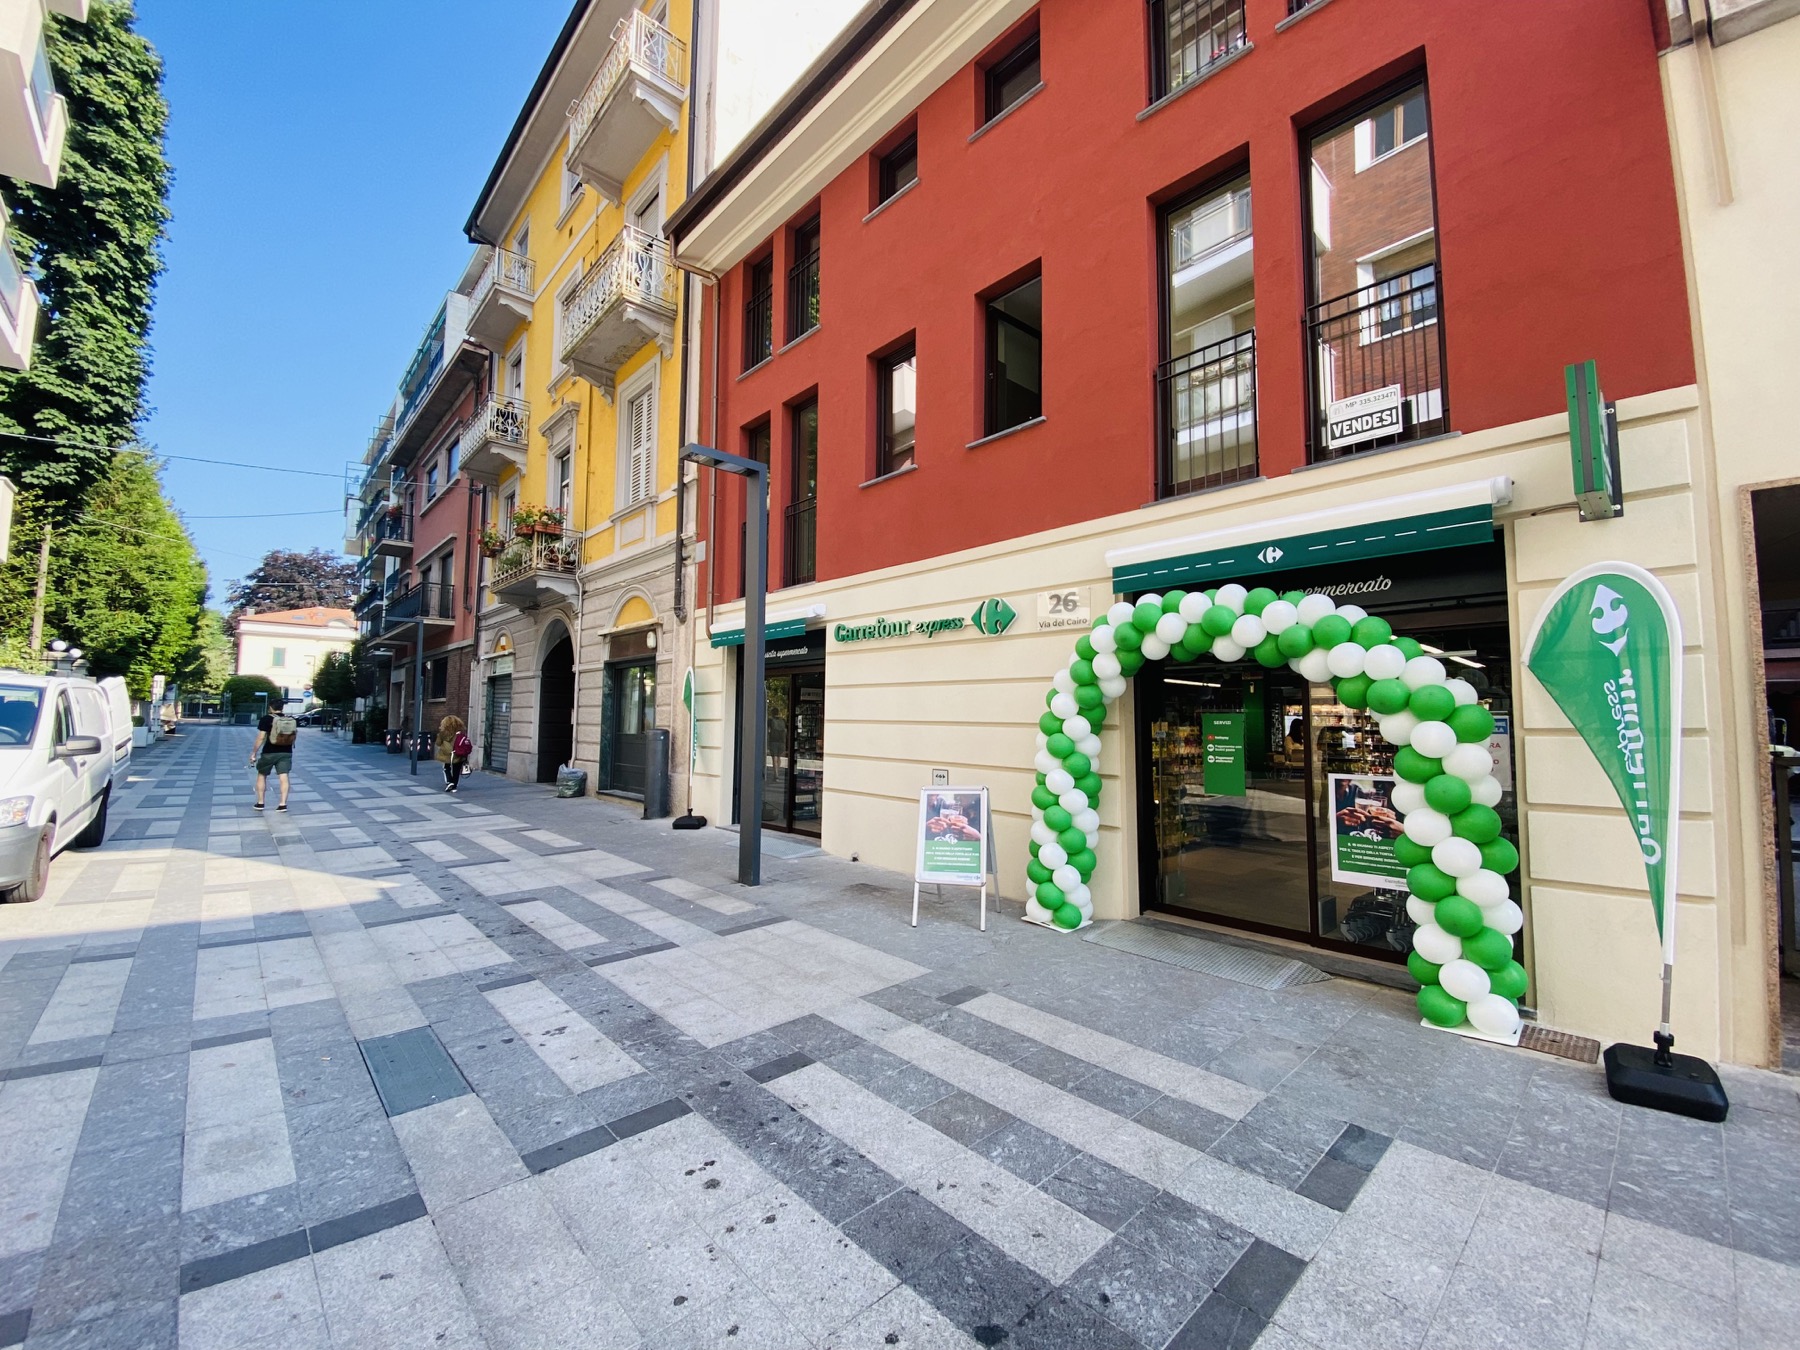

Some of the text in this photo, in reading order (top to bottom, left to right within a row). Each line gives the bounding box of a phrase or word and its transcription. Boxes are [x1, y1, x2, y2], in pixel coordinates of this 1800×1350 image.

[1332, 408, 1397, 438] VENDESI
[1279, 574, 1392, 597] ermercato
[1049, 591, 1077, 614] 26
[834, 616, 965, 643] Carrefour express
[1039, 617, 1088, 628] Via del Cairo
